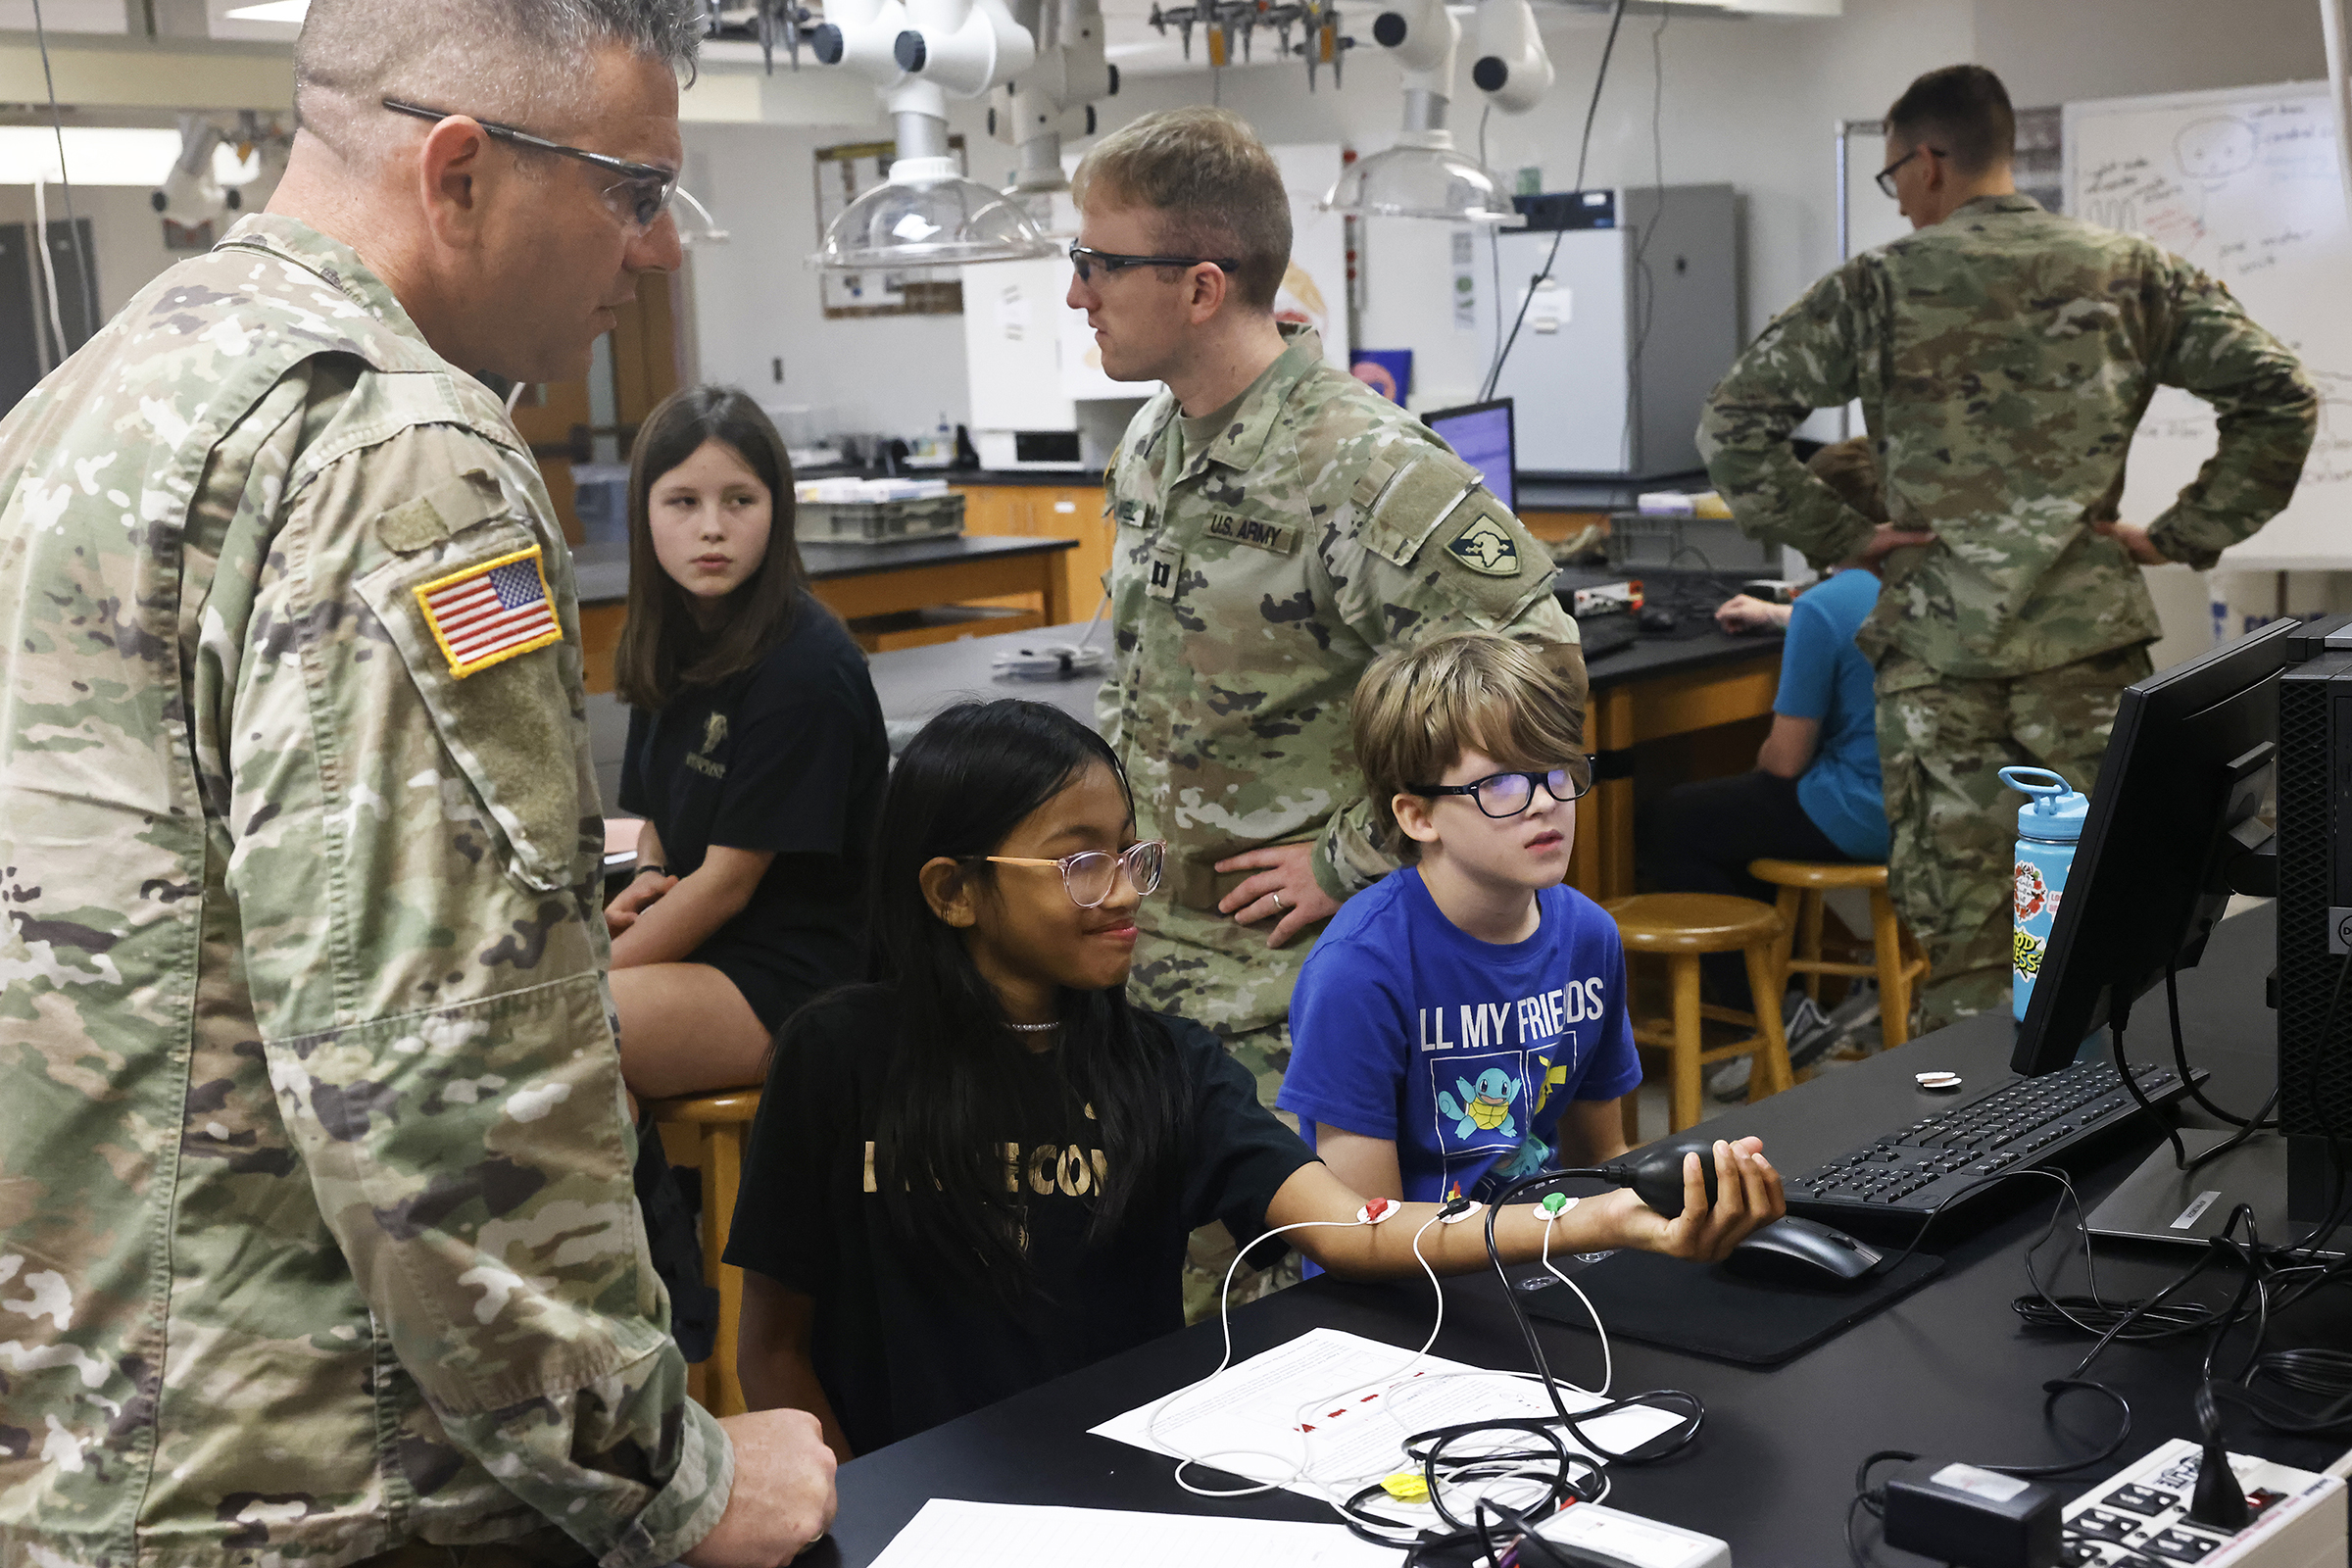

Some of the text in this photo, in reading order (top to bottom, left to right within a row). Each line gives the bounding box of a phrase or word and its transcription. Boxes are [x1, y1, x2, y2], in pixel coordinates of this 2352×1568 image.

[1210, 514, 1282, 546] U.S. ARMY
[2014, 946, 2037, 971] ESS
[1419, 976, 1604, 1053] LL MY FRIEDS
